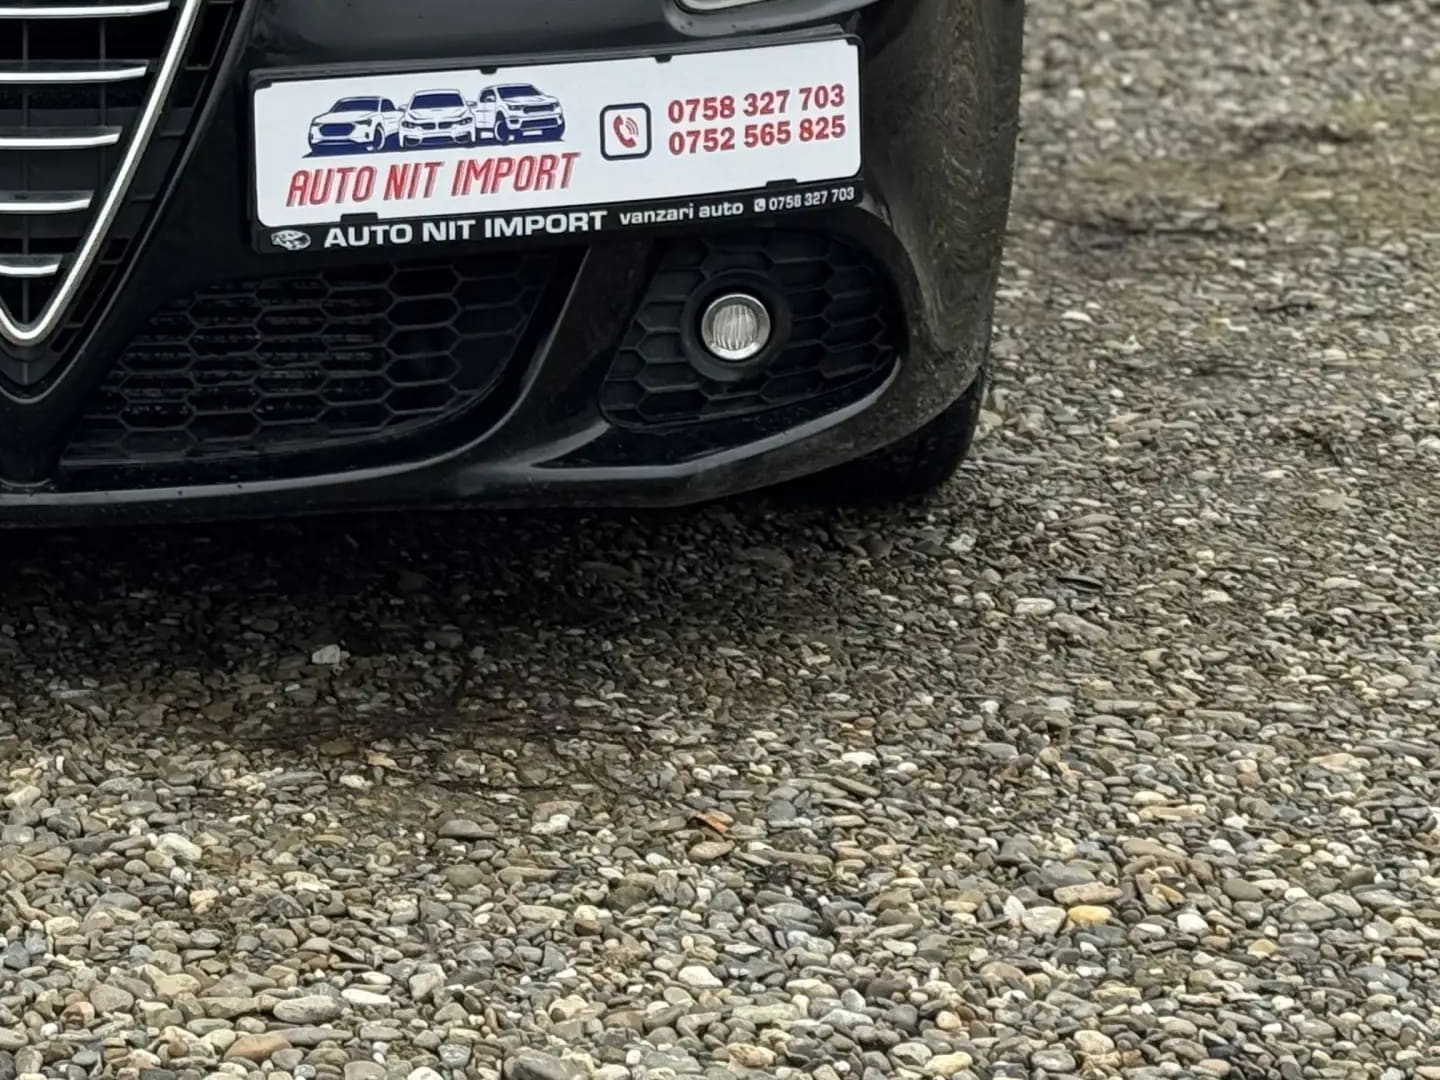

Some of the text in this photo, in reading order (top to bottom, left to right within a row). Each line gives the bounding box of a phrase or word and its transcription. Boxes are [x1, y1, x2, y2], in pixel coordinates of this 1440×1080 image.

[667, 83, 845, 124] 0758 327 703
[668, 114, 846, 156] 0752 565 825
[286, 151, 582, 207] AUTO NIT IMPORT
[323, 186, 855, 249] AUTO NIT IMPORT vanzari auto 0758 327 703
